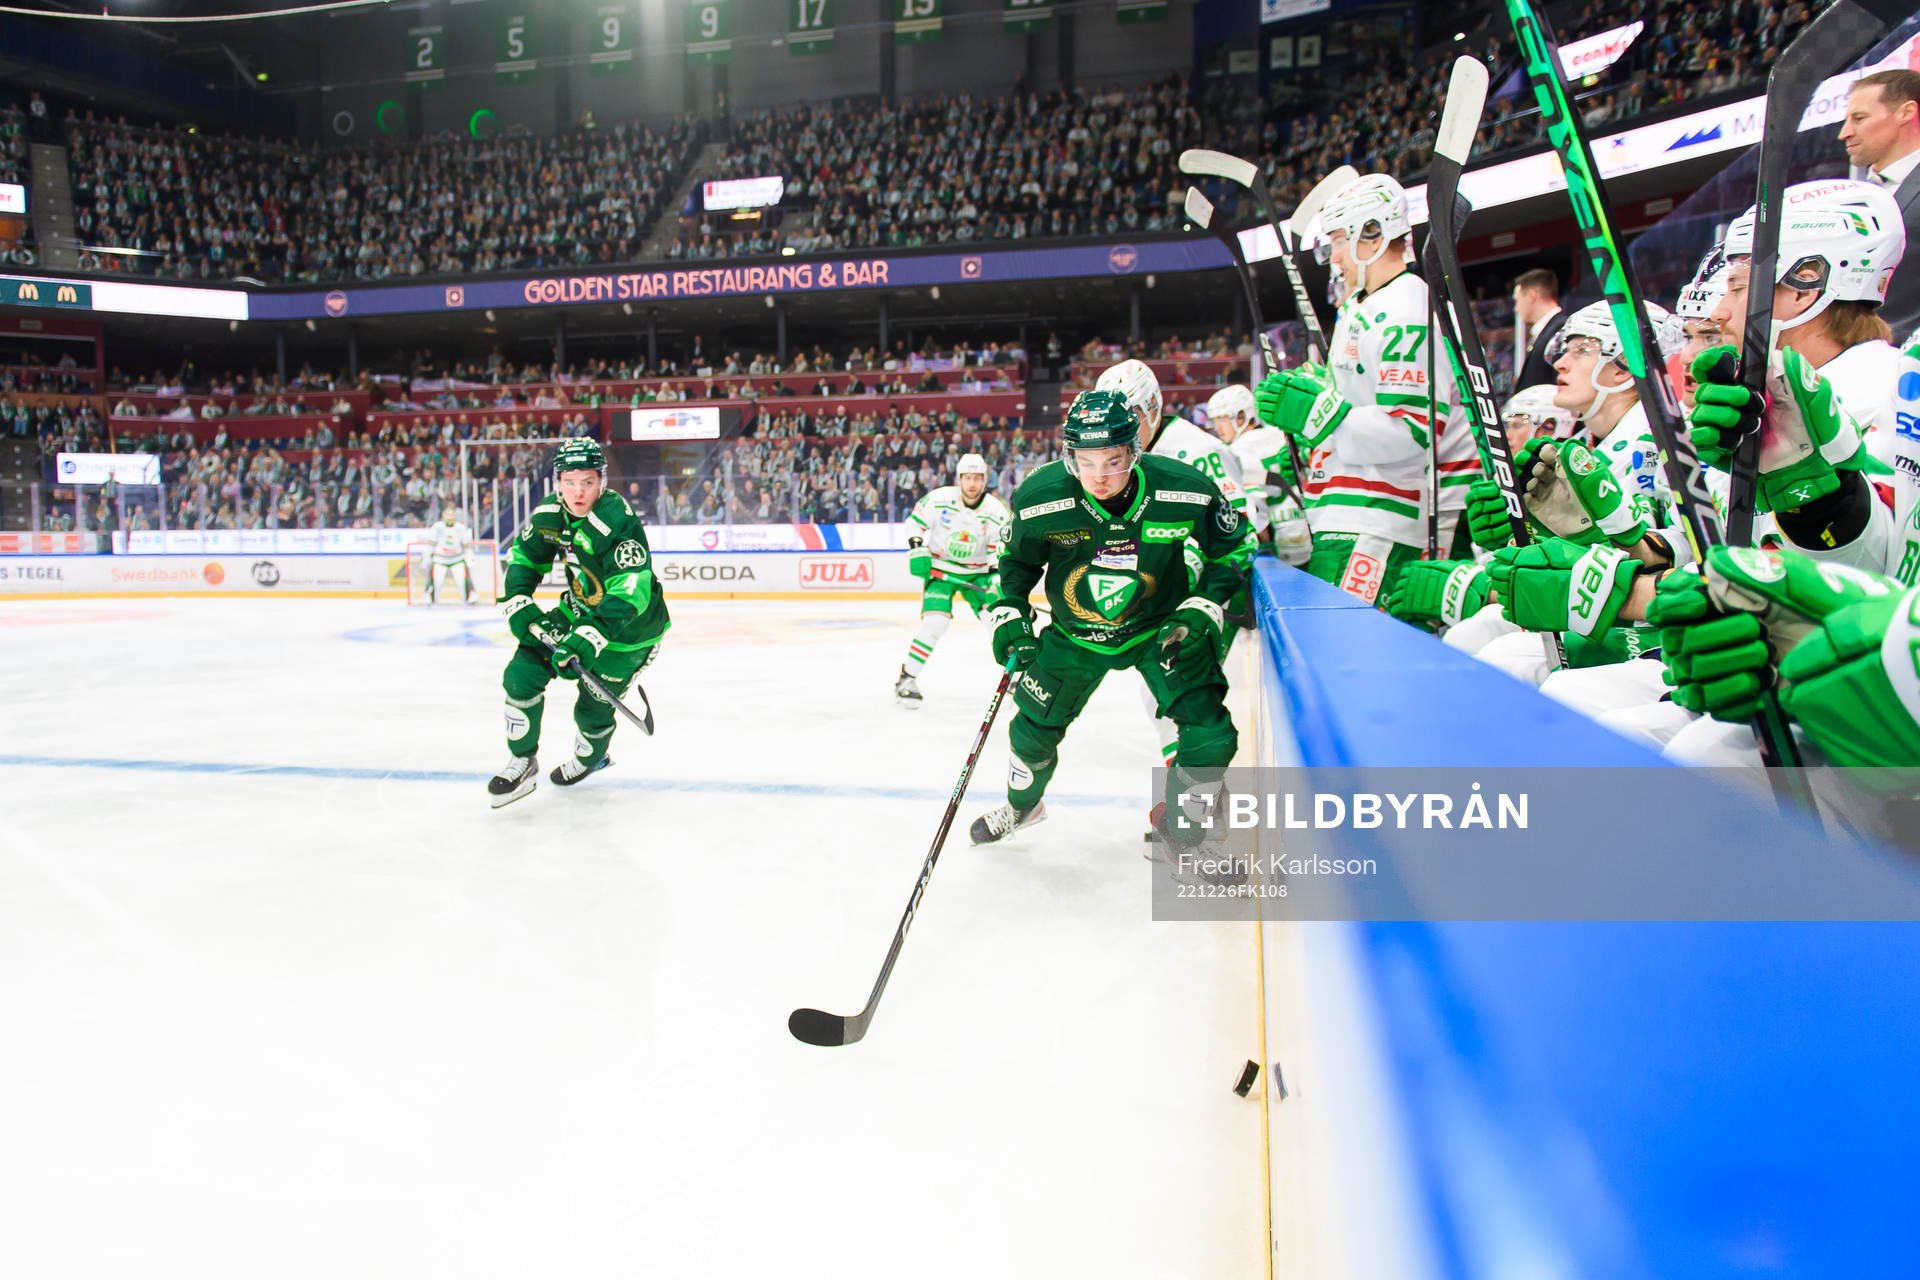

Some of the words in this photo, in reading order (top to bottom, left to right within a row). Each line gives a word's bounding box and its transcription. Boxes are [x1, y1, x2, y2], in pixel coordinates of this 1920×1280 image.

[701, 6, 719, 38] 9
[797, 0, 827, 28] 17
[507, 27, 524, 58] 5
[603, 17, 620, 48] 9
[417, 37, 434, 67] 2
[524, 276, 613, 304] GOLDEN
[617, 273, 668, 299] STAR
[673, 263, 813, 295] RESTAURANG
[818, 263, 837, 288] &
[843, 260, 889, 286] BAR
[1381, 325, 1428, 362] 27
[1080, 431, 1109, 440] KEWAB
[1469, 364, 1524, 519] BAUER
[1192, 452, 1227, 480] 28
[1080, 498, 1104, 523] stadium
[1132, 495, 1151, 523] stadium
[1145, 527, 1189, 538] coop
[16, 567, 65, 581] TEGEL
[111, 567, 198, 582] Swedbank
[663, 561, 756, 581] ŠKODA
[803, 563, 871, 582] JULA
[1097, 579, 1115, 597] F
[1105, 591, 1124, 611] BK
